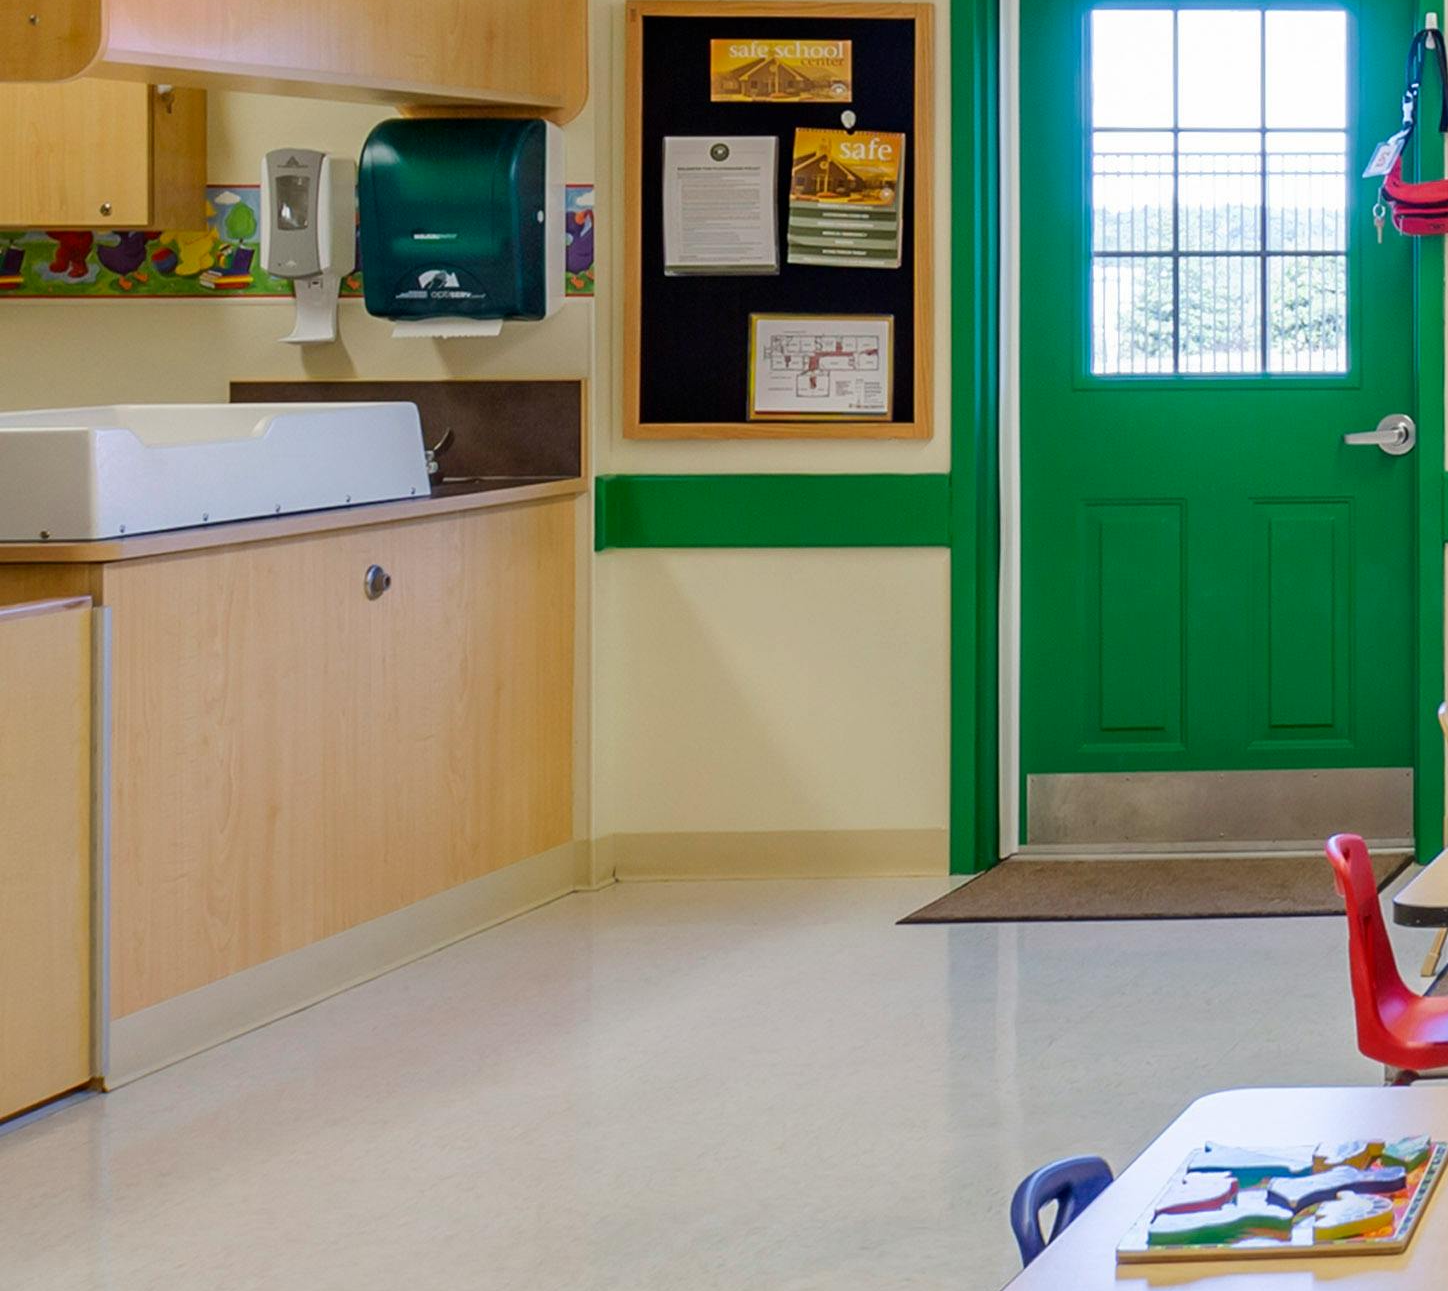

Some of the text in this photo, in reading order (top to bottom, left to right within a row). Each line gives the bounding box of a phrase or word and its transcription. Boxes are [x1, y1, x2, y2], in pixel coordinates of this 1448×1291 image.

[729, 40, 844, 58] safe school
[800, 58, 844, 67] center
[839, 138, 893, 161] safe
